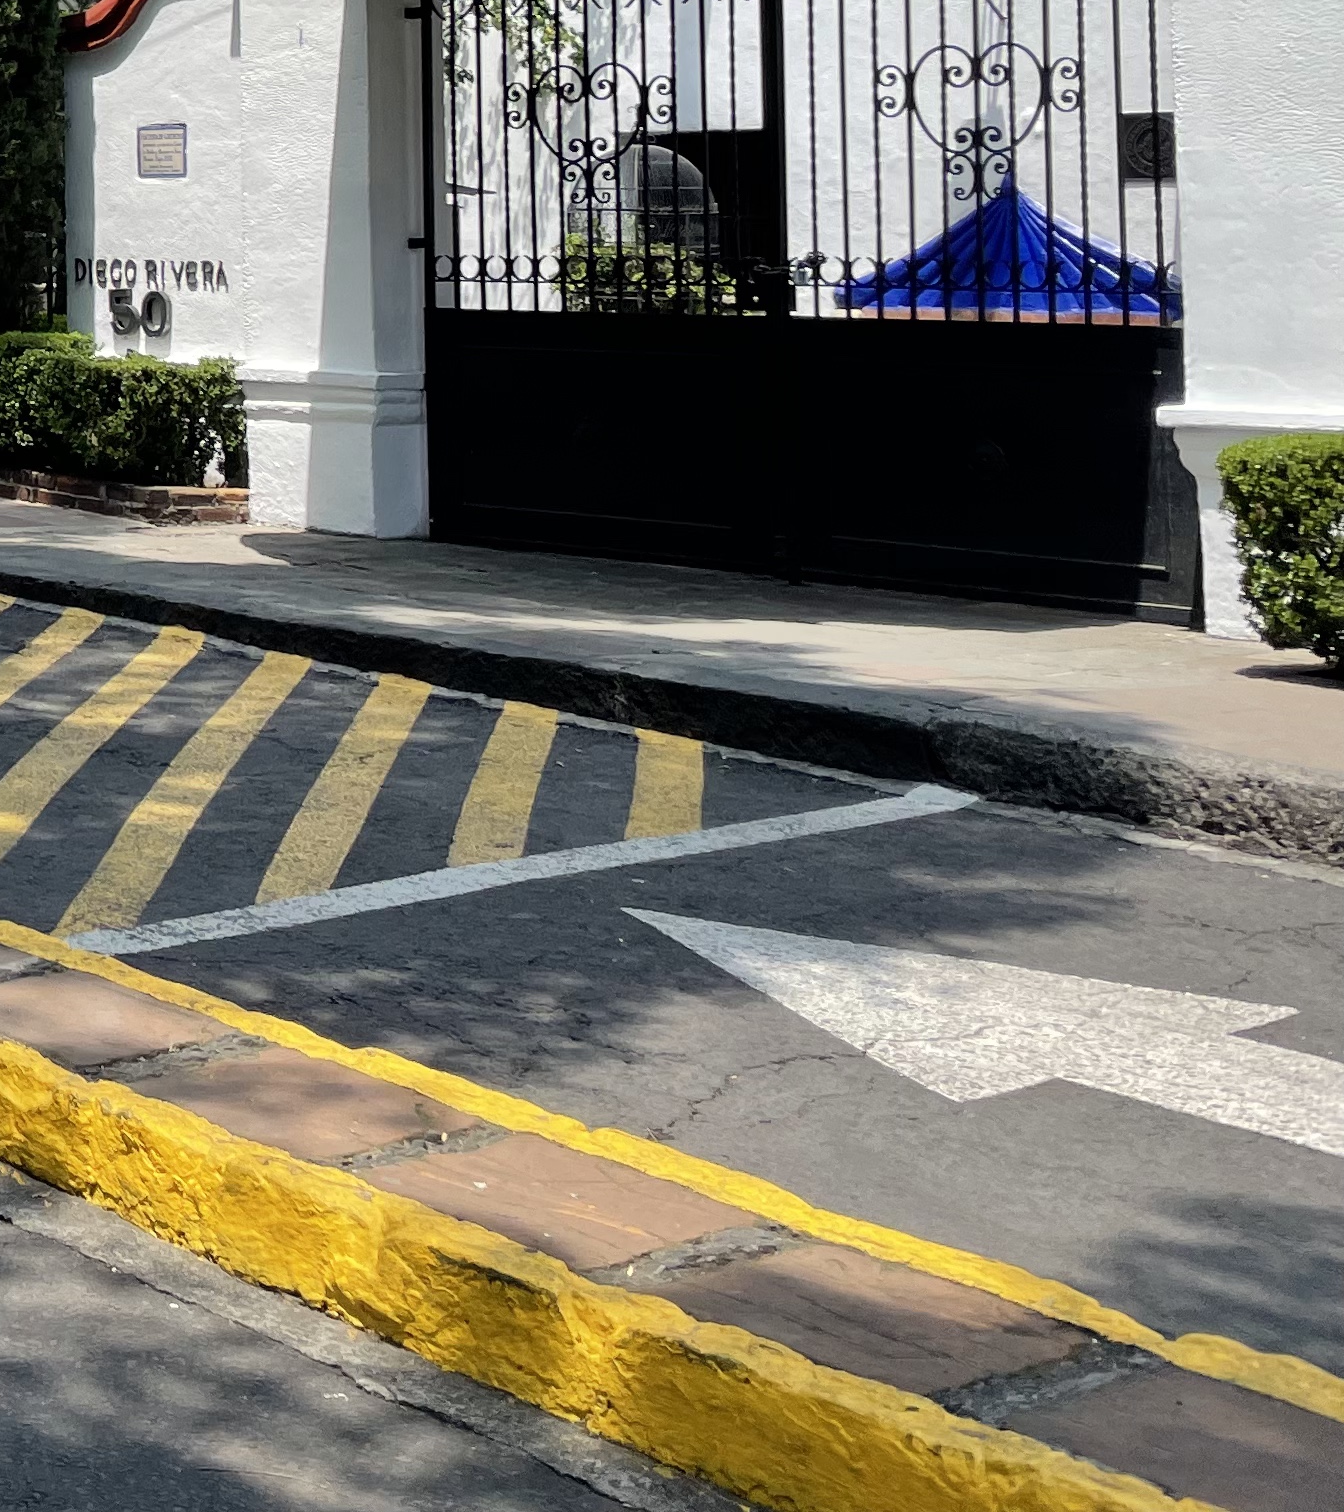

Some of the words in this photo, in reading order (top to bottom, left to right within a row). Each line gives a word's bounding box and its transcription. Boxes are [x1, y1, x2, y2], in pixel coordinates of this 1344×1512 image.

[74, 258, 137, 287] DIEGO
[144, 259, 229, 292] RIVERA
[108, 288, 172, 337] 50
